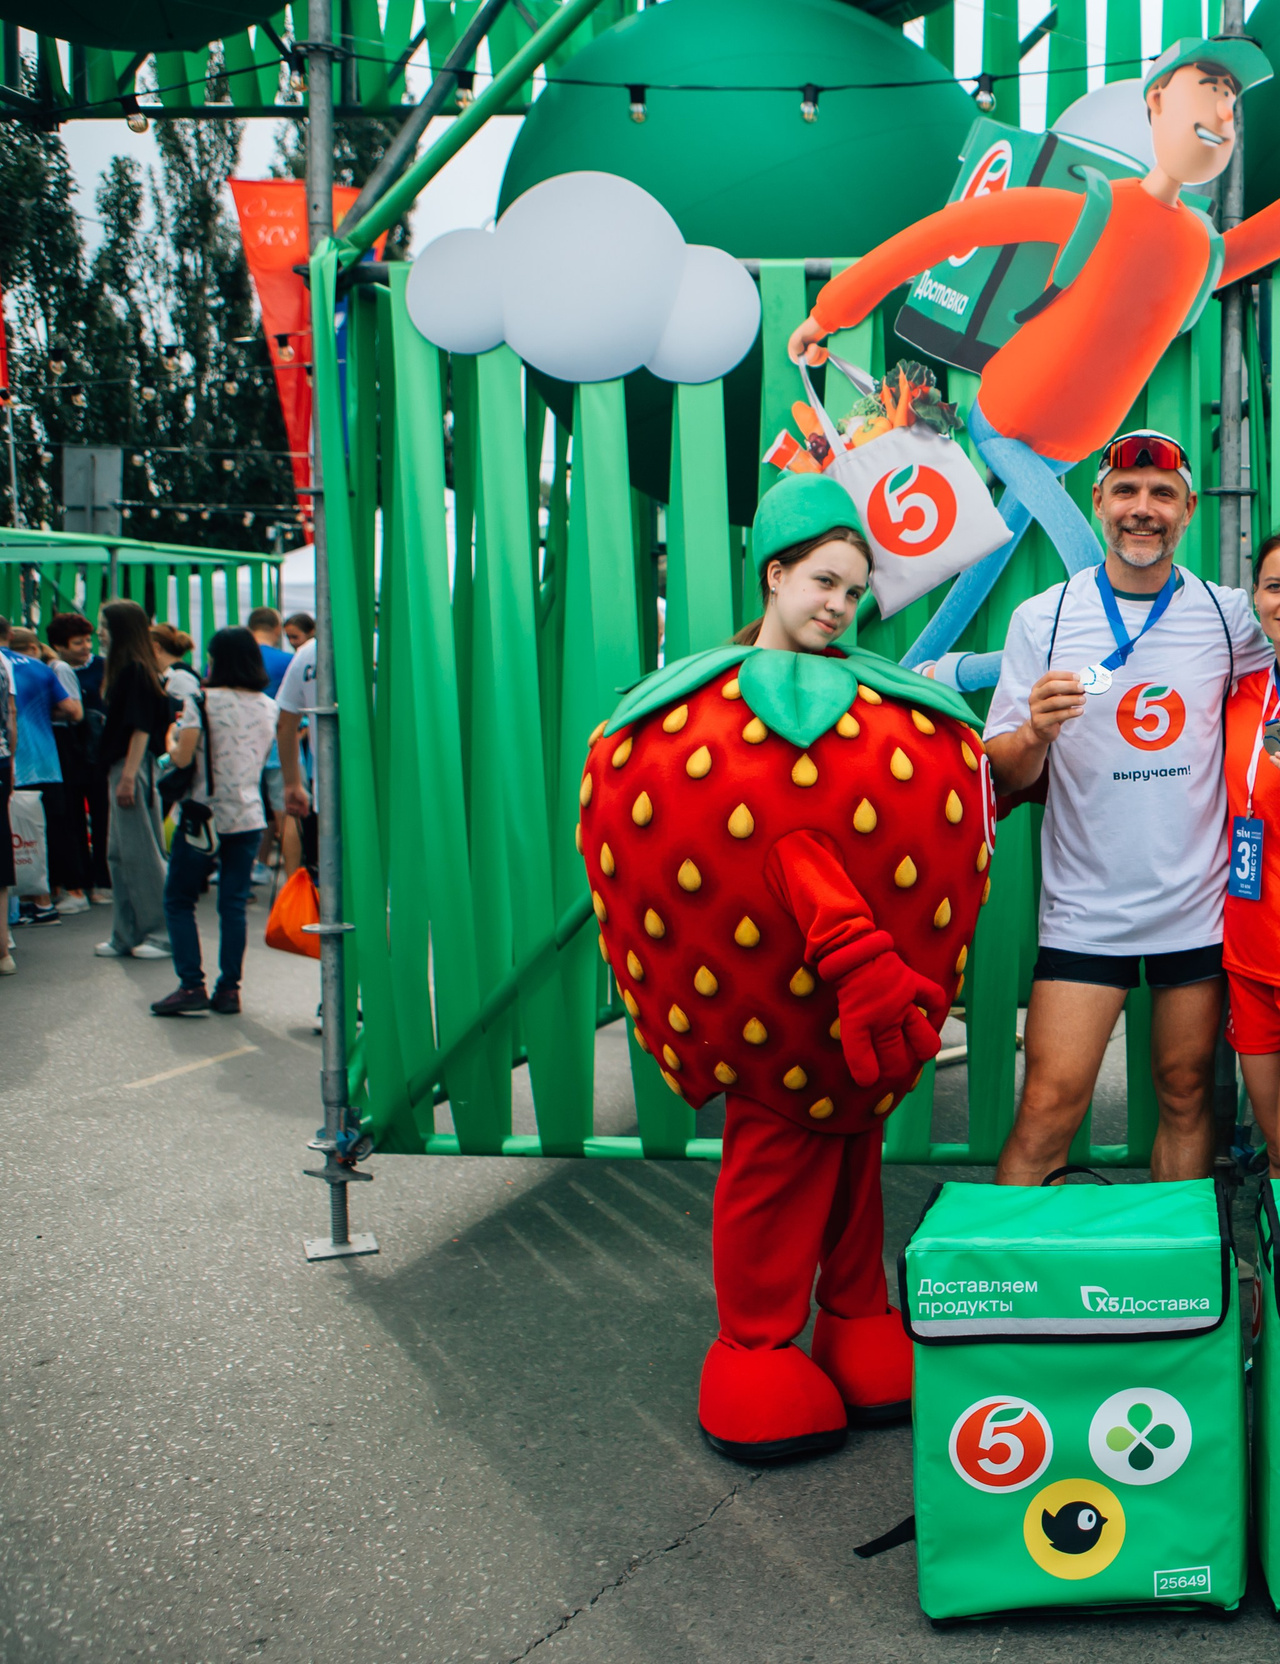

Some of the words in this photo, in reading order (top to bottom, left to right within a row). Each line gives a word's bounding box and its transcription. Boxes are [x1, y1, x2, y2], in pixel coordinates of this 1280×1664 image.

[913, 269, 969, 315] Доставка
[883, 463, 939, 544] 5
[1132, 682, 1173, 742] 5
[1113, 765, 1191, 781] выручает!
[1236, 841, 1250, 880] 3
[917, 1278, 1039, 1296] Доставляем
[918, 1298, 1014, 1317] продукты
[977, 1403, 1030, 1475] 5
[1159, 1573, 1207, 1590] 25649
